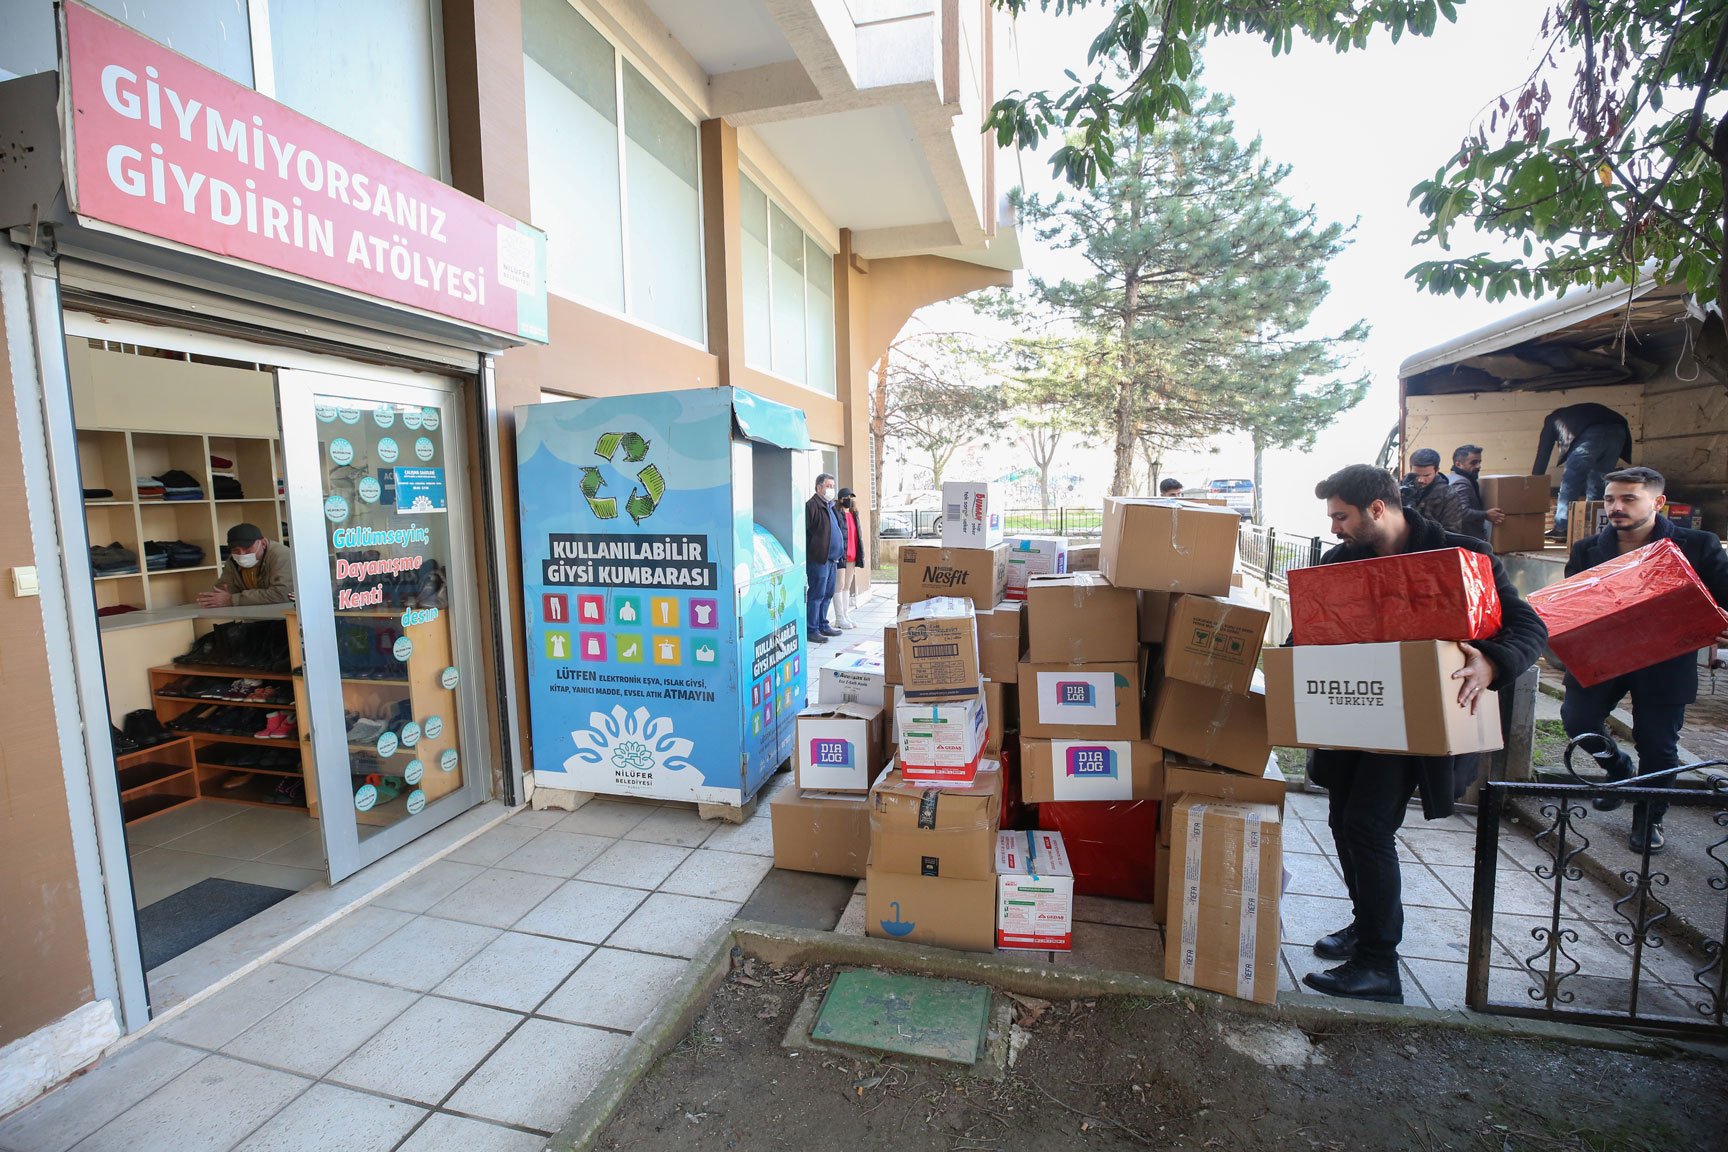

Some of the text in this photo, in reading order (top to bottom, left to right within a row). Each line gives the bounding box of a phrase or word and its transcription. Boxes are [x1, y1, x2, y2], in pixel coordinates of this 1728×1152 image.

[101, 65, 447, 243] GİYMİYORSANIZ
[106, 142, 485, 305] GİYDİRİN ATÖLYESİ
[334, 524, 429, 548] Gülümseyin;
[553, 537, 702, 561] KULLANILABİLİR
[336, 555, 422, 581] Dayanışma
[548, 561, 709, 586] GİYSİ KUMBARASI
[922, 566, 970, 588] Nesfit
[338, 584, 383, 609] Kenti
[556, 666, 707, 690] LÜTFEN ELEKTRONİK EŞYA, ISLAK GİYSİ,
[1306, 680, 1384, 696] DIALOG
[550, 683, 715, 702] KİTAP, YANICI MADDE, EVSEL ATIK ATMAYIN
[1066, 686, 1084, 694] DIA
[820, 743, 842, 753] DIA
[820, 753, 843, 763] LOG
[1078, 752, 1104, 762] DIA
[616, 770, 653, 779] NİLÜFER
[1078, 762, 1104, 772] LOG
[616, 778, 652, 786] BELEDİYESİ
